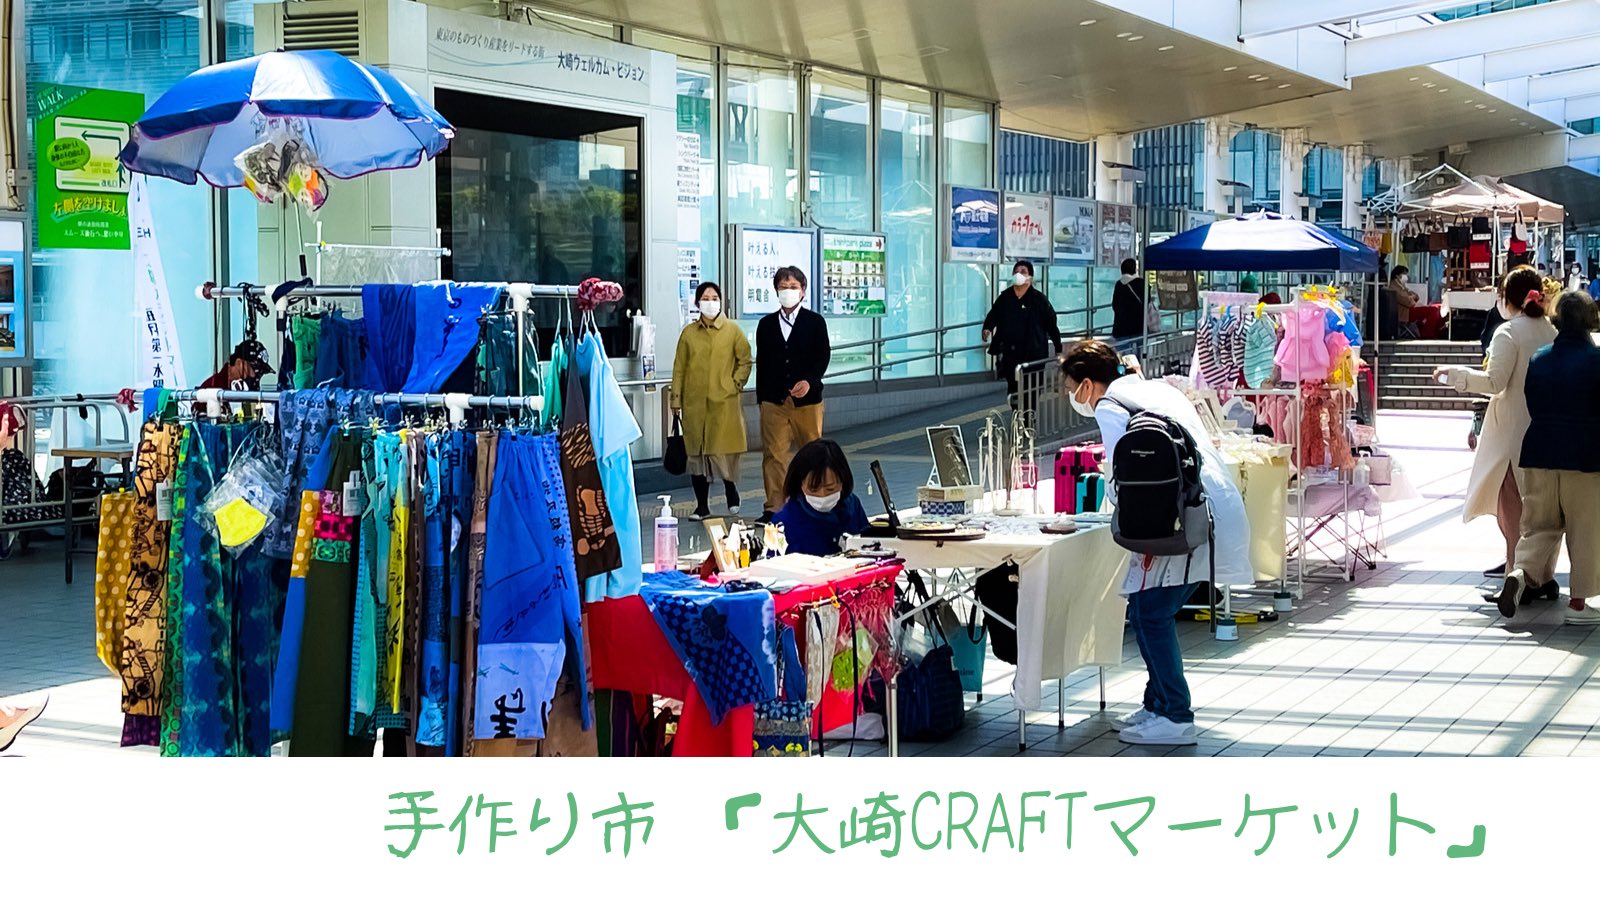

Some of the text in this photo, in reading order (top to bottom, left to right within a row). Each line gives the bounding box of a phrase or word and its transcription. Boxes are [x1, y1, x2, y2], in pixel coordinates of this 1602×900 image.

[557, 50, 644, 81] 大崎ウェルカム・ビジョン
